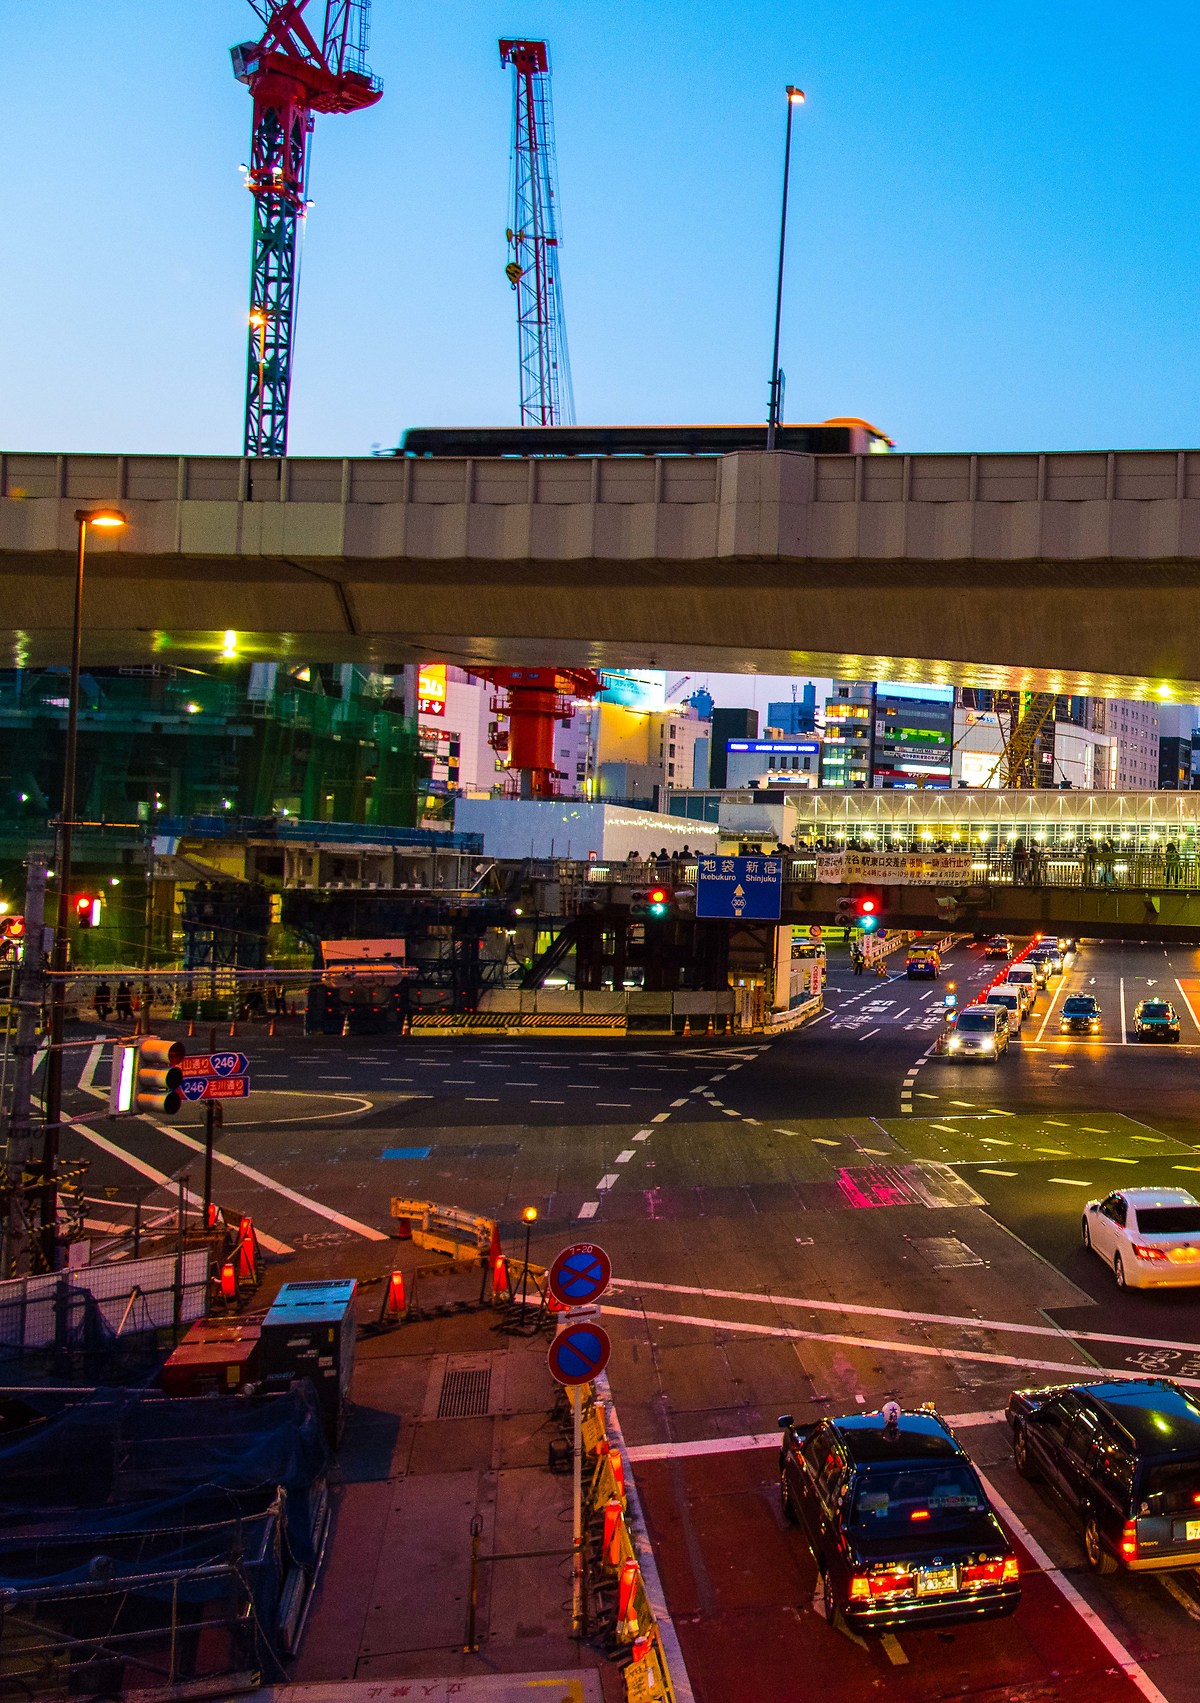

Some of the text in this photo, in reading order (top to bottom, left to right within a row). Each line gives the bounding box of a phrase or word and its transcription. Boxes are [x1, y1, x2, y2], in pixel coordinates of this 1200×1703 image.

[703, 859, 777, 874] 池袋 新宿
[700, 873, 777, 883] Ikebukuro Shinjuku
[214, 1056, 234, 1069] 246
[184, 1082, 204, 1093] 246
[209, 1080, 244, 1090] 玉川通り
[570, 1245, 593, 1255] 7-20
[368, 1683, 466, 1698] 立入禁止
